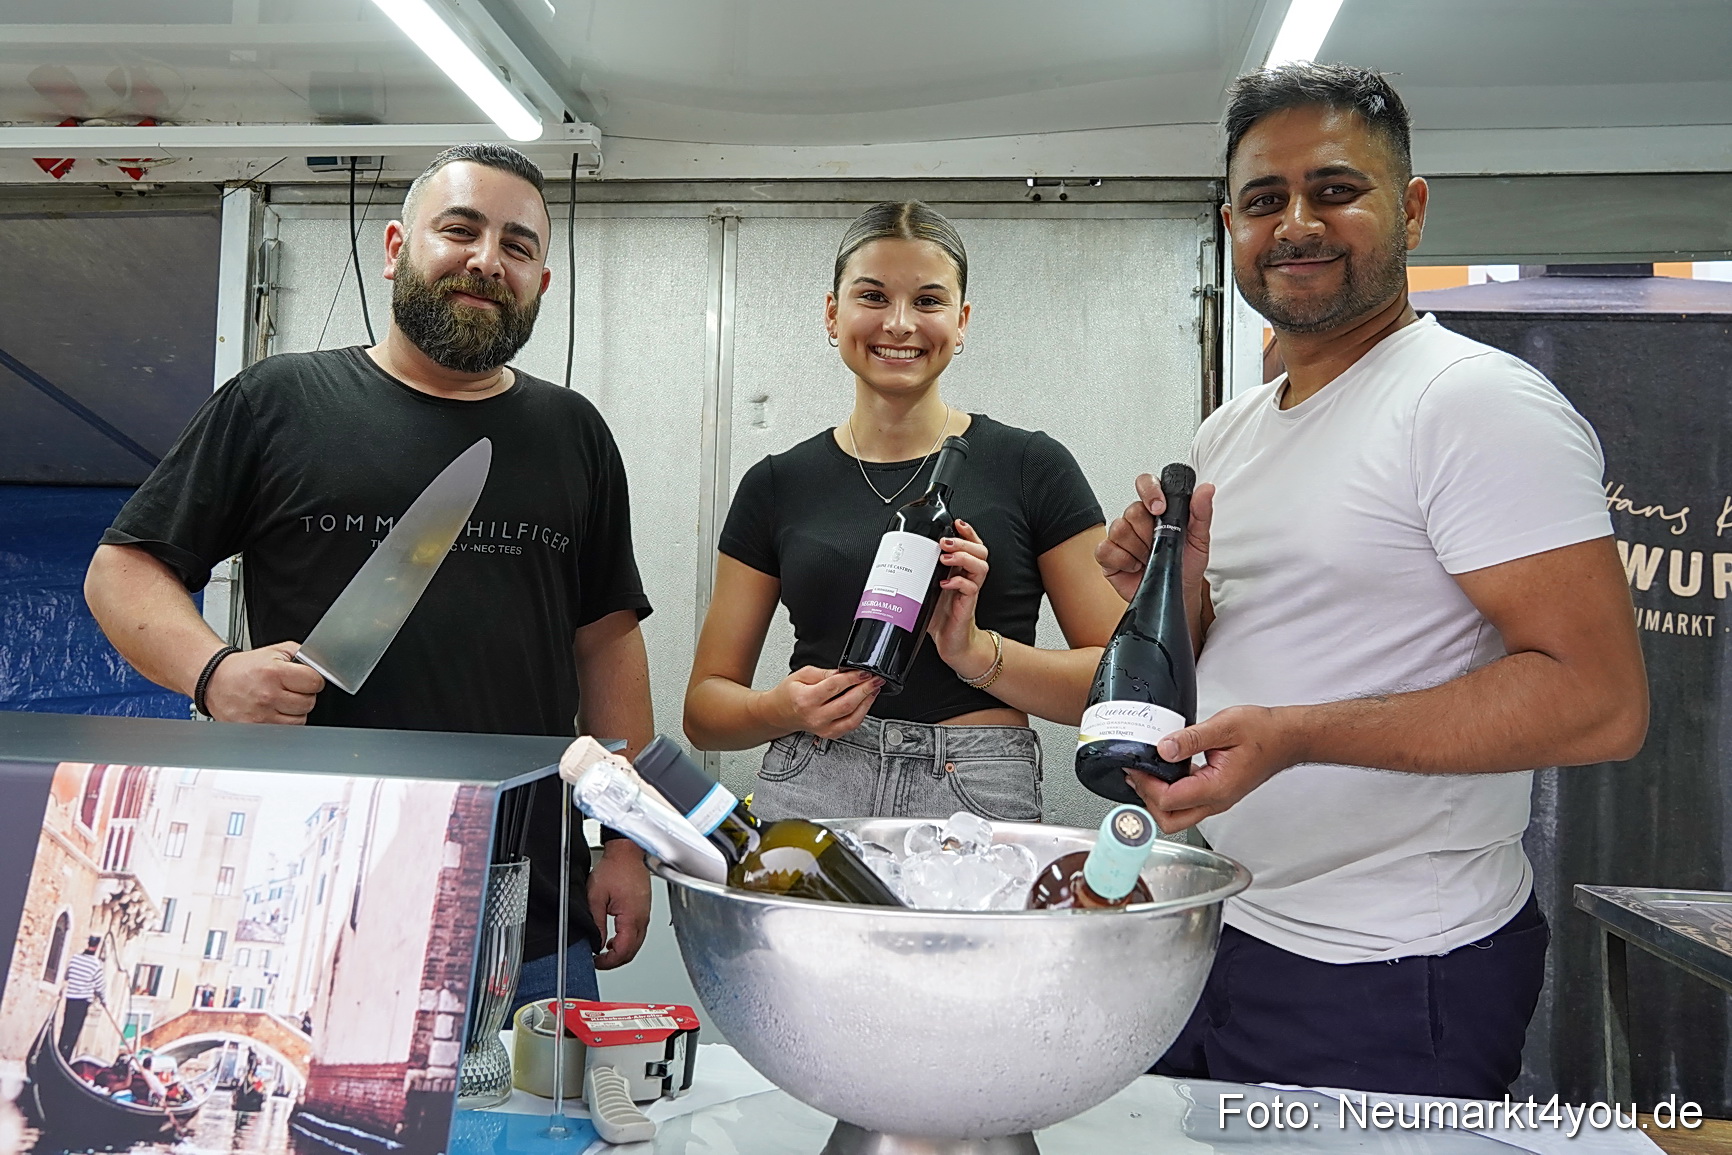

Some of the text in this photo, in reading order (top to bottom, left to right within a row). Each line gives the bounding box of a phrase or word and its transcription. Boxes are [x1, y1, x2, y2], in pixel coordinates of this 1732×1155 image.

[300, 514, 570, 554] TOMM HILFIGER
[498, 544, 523, 555] TEES
[1617, 539, 1732, 599] WUR
